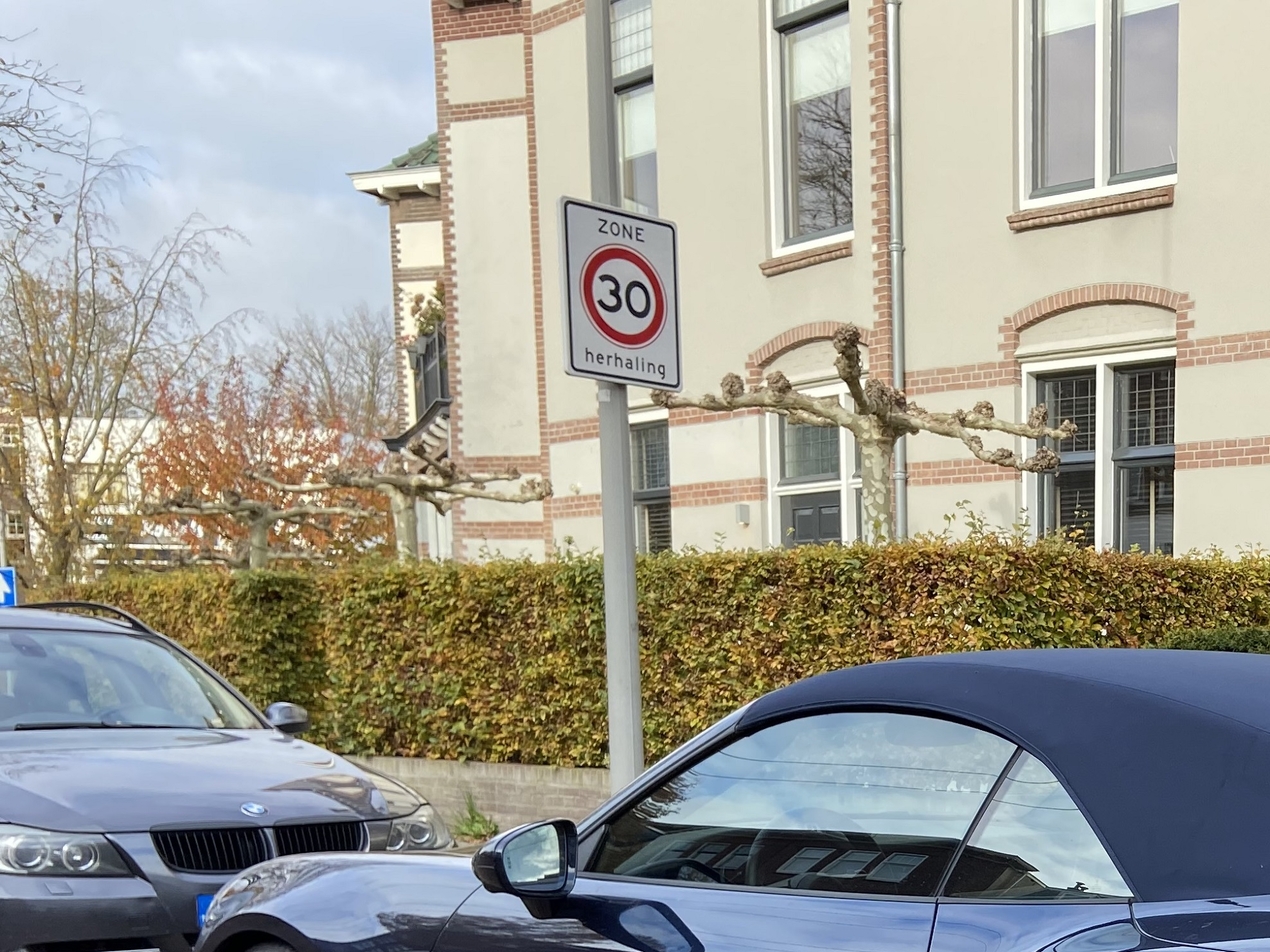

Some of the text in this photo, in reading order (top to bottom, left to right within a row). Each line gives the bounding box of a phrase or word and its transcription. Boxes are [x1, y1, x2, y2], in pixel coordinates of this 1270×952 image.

[597, 218, 645, 243] ZONE
[596, 273, 651, 319] 30
[585, 347, 667, 380] herhaling
